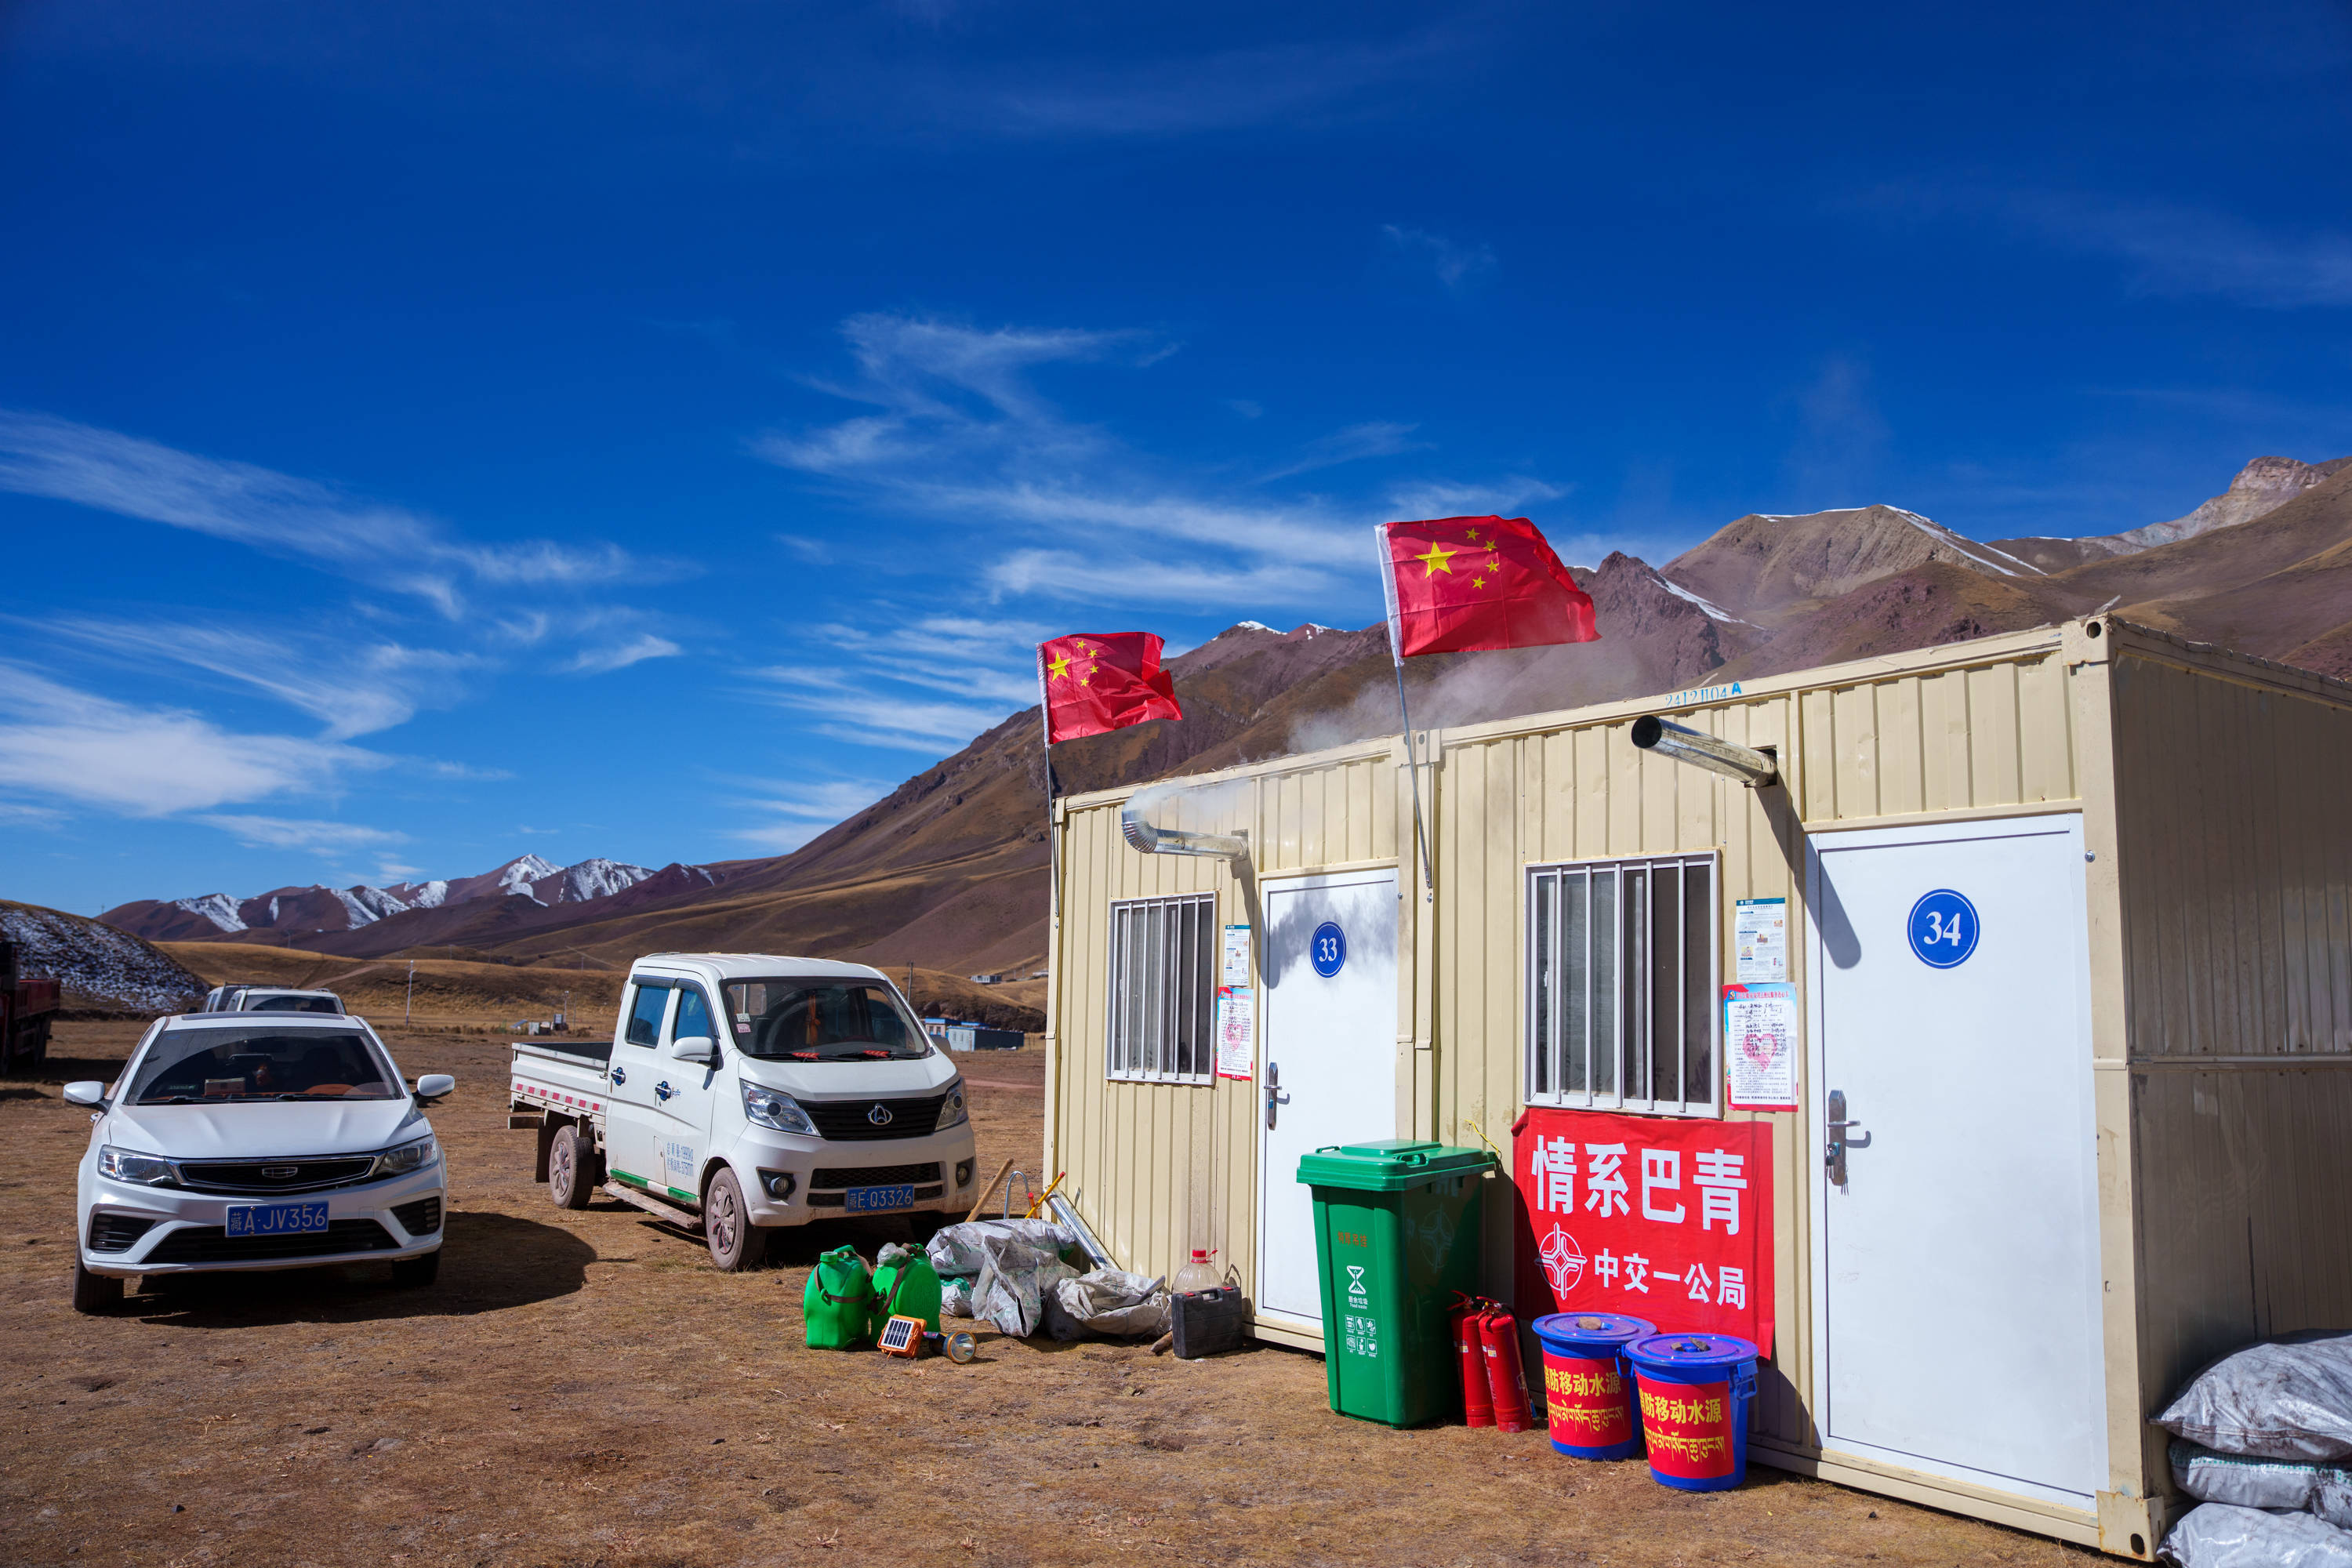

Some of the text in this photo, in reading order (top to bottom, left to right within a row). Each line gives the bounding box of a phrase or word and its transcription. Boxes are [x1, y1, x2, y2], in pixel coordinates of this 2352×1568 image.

[1319, 937, 1338, 963] 33
[1923, 911, 1962, 946] 34
[1530, 1134, 1748, 1236] 情系巴青
[1594, 1248, 1746, 1310] 中交一公局
